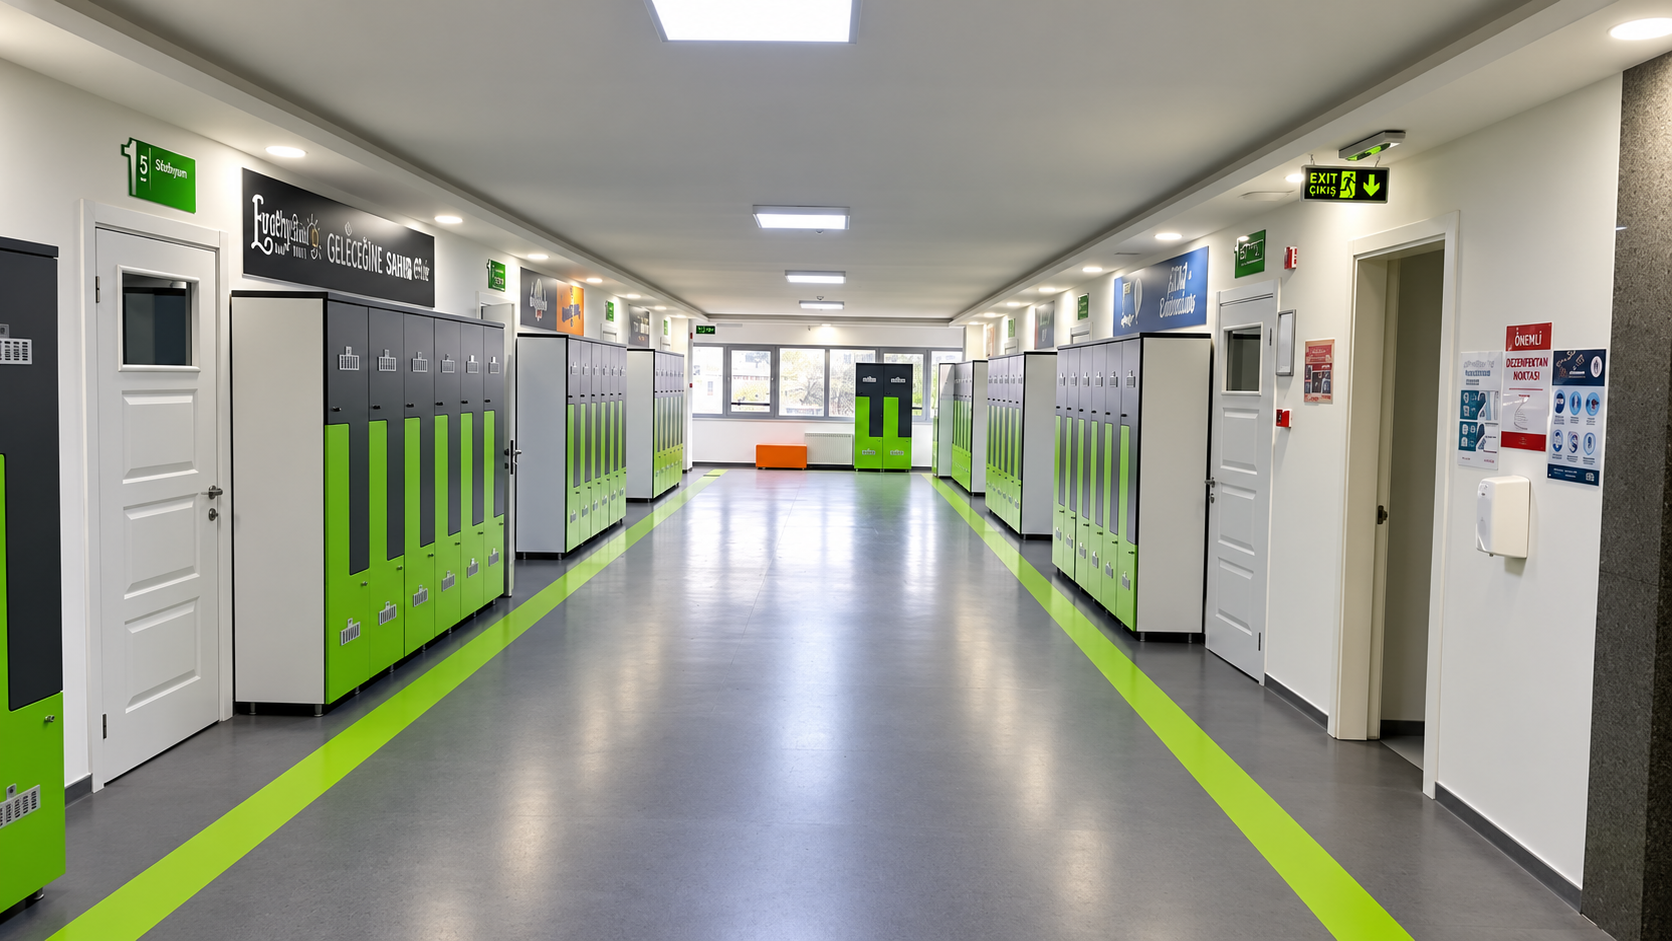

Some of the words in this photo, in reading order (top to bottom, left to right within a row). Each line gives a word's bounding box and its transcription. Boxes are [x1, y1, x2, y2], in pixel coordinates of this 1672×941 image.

[140, 154, 148, 175] 5
[1310, 172, 1338, 184] EXIT
[1309, 185, 1337, 197] ÇIKIŞ
